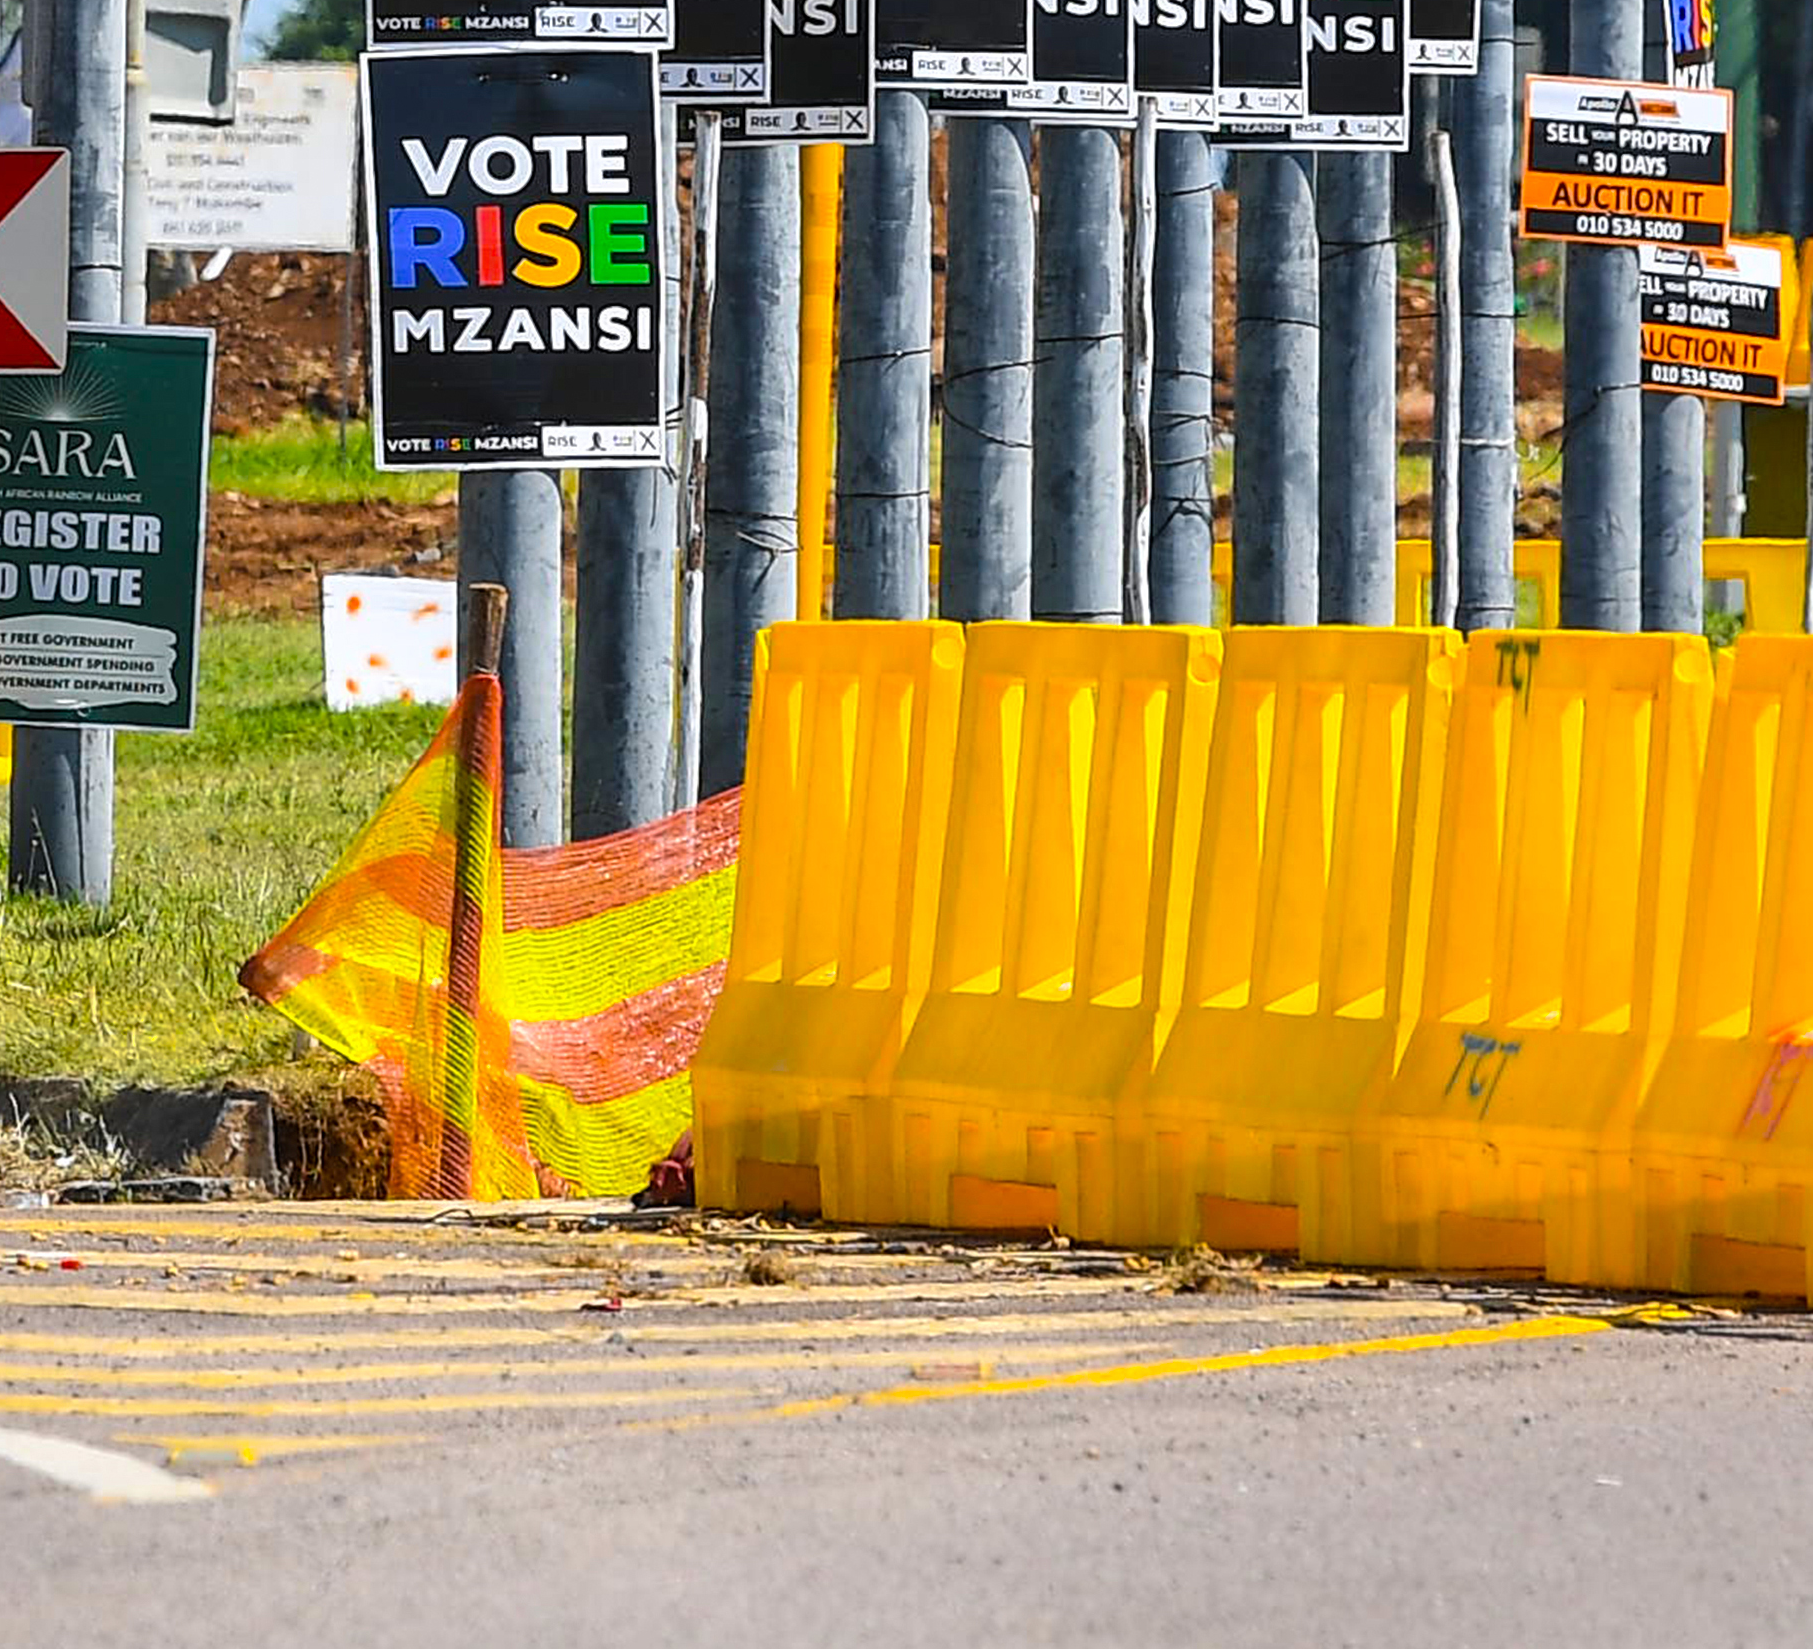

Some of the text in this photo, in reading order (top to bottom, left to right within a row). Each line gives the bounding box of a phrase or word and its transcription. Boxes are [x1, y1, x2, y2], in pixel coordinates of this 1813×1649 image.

[376, 17, 528, 30] VOTE RISE MZANSI
[540, 15, 575, 27] RISE
[1546, 123, 1589, 144] SELL
[1619, 129, 1711, 154] PROPERTY
[1594, 152, 1667, 176] 30 DAYS
[1552, 182, 1703, 216] AUCTION IT
[1577, 216, 1684, 240] 010 534 5000
[6, 489, 142, 503] AFRICAN RAINBOW ALLIANCE
[29, 564, 143, 605] VOTE
[10, 633, 134, 649] FREE GOVERNMENT
[87, 659, 154, 672] SPENDING
[75, 680, 165, 695] DEPARTMENTS
